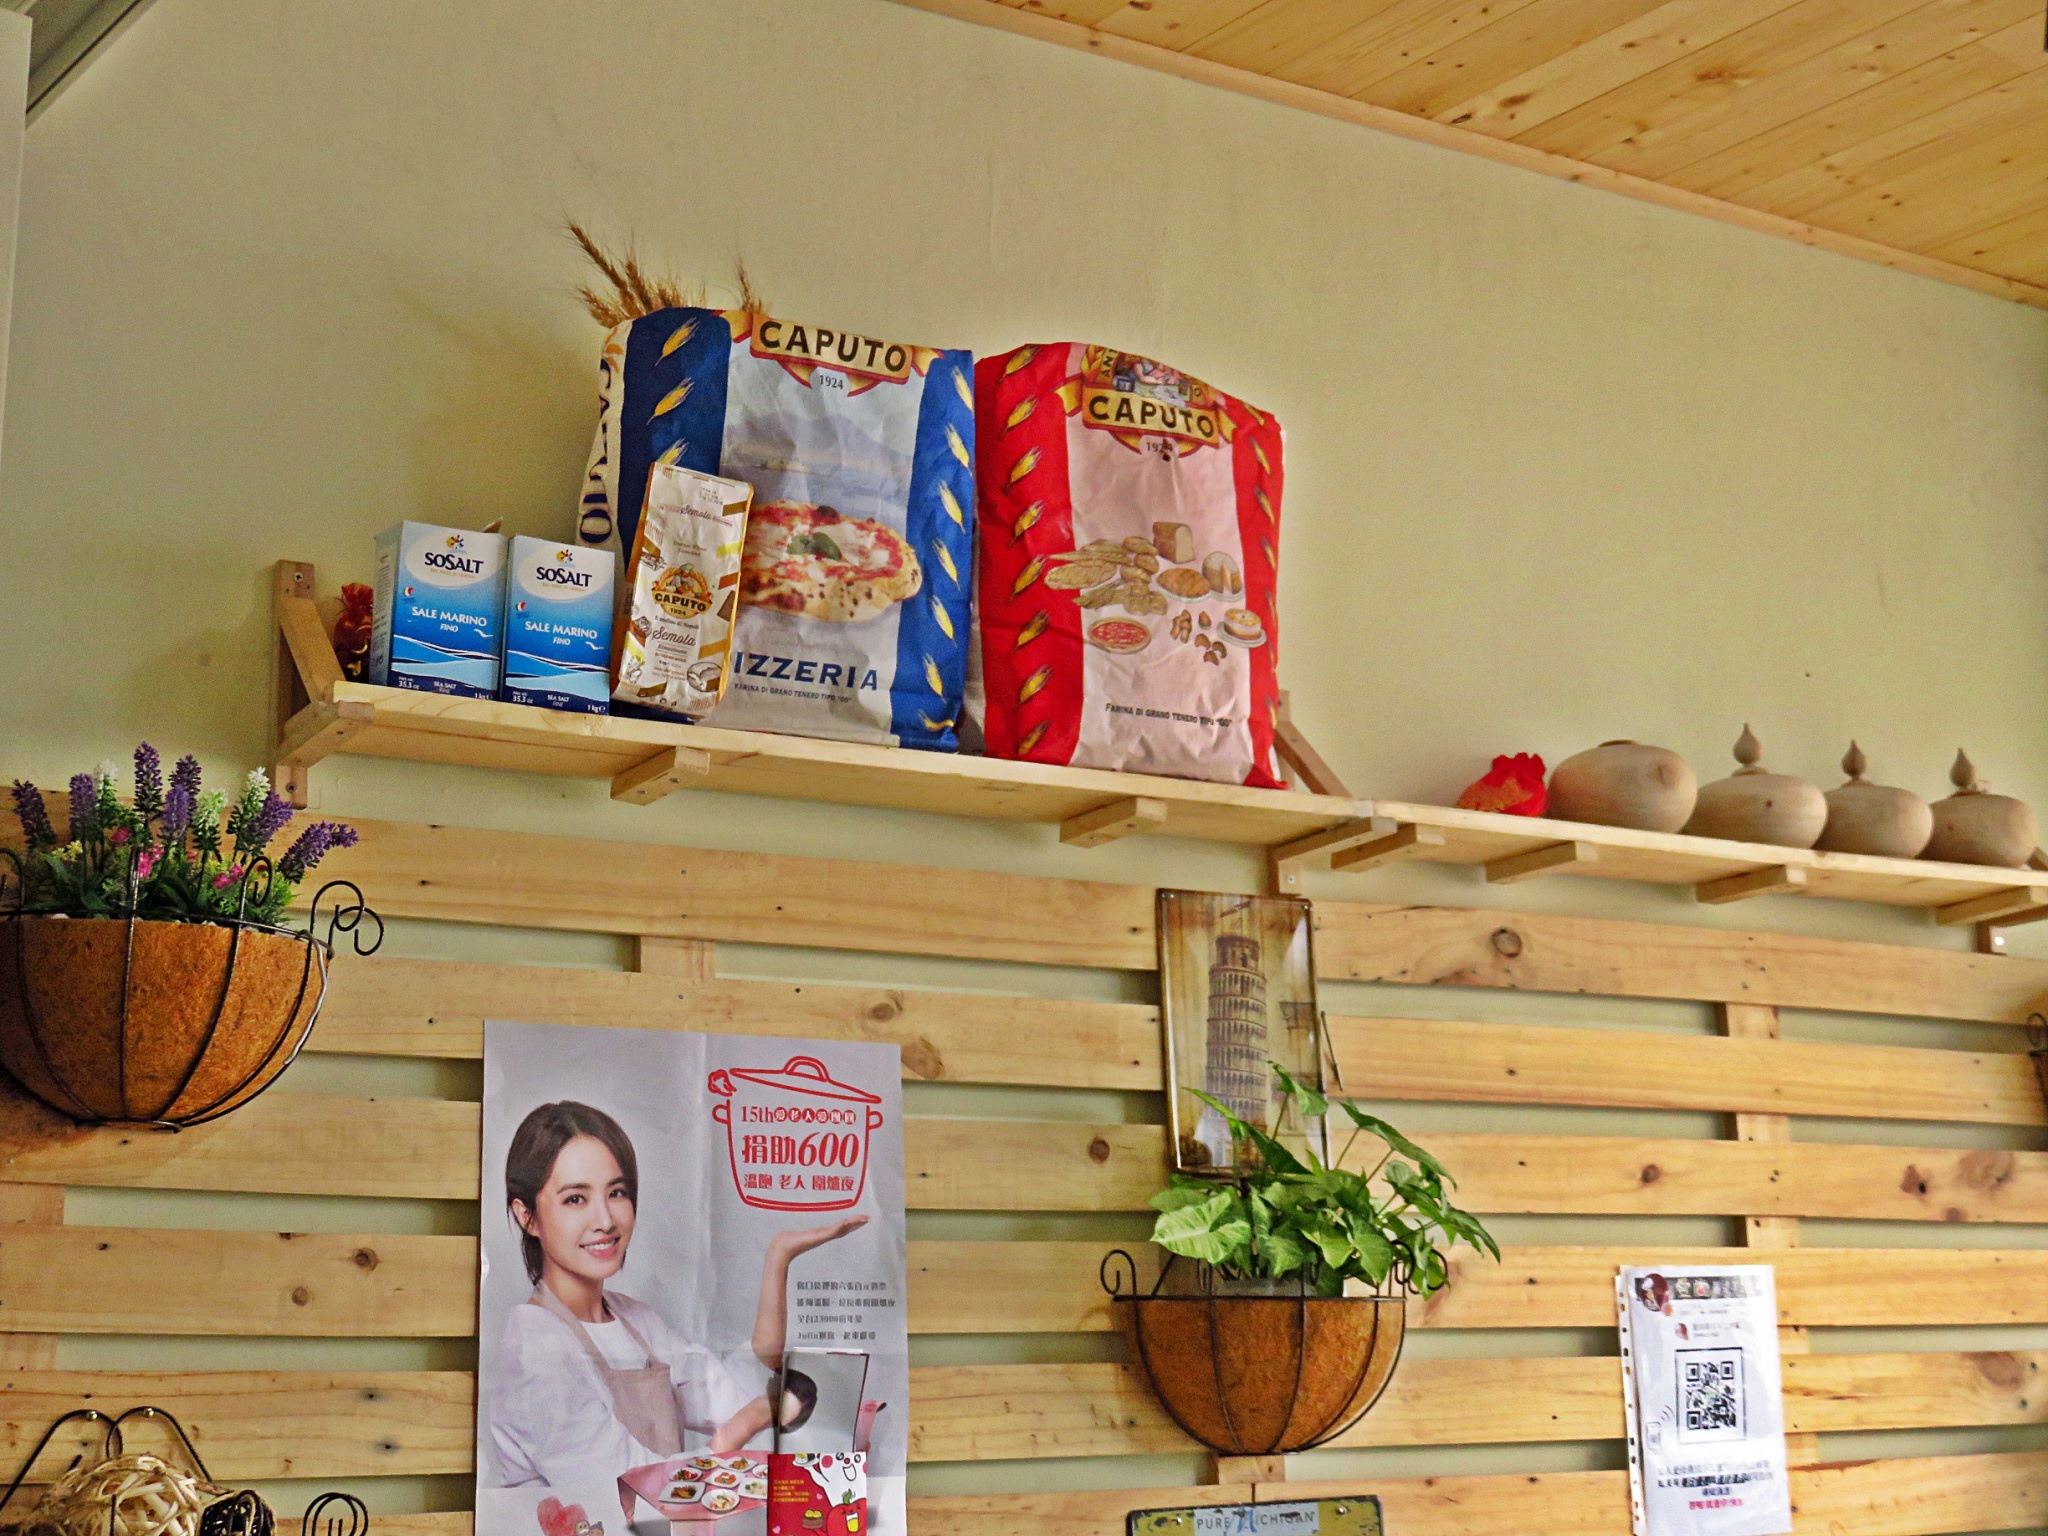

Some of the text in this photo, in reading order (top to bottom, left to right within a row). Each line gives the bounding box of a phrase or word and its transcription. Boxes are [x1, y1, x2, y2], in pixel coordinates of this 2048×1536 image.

[760, 321, 906, 372] CAPUTO
[819, 375, 844, 390] 1924
[1088, 396, 1214, 438] CAPUTO
[424, 552, 484, 574] SOSALT
[536, 566, 592, 587] SOSALT
[654, 592, 707, 612] CAPUTO
[670, 607, 686, 616] 1924
[411, 606, 487, 627] SALE MARINO
[440, 623, 459, 632] FINO
[525, 620, 598, 639] SALE MARINO
[652, 626, 696, 647] Semola
[552, 637, 571, 645] FINO
[734, 651, 878, 691] IZZERIA
[513, 695, 526, 703] 35.3
[734, 683, 759, 693] FARINA
[770, 687, 792, 696] GRANO
[794, 690, 820, 699] TENERO
[1105, 703, 1133, 715] FARINA
[1135, 708, 1143, 716] DI
[1145, 709, 1170, 719] GRANO
[1172, 712, 1198, 724] TENERO
[741, 1131, 860, 1168] 捐助600
[780, 1174, 806, 1190] 老人
[1197, 1517, 1230, 1529] PURE
